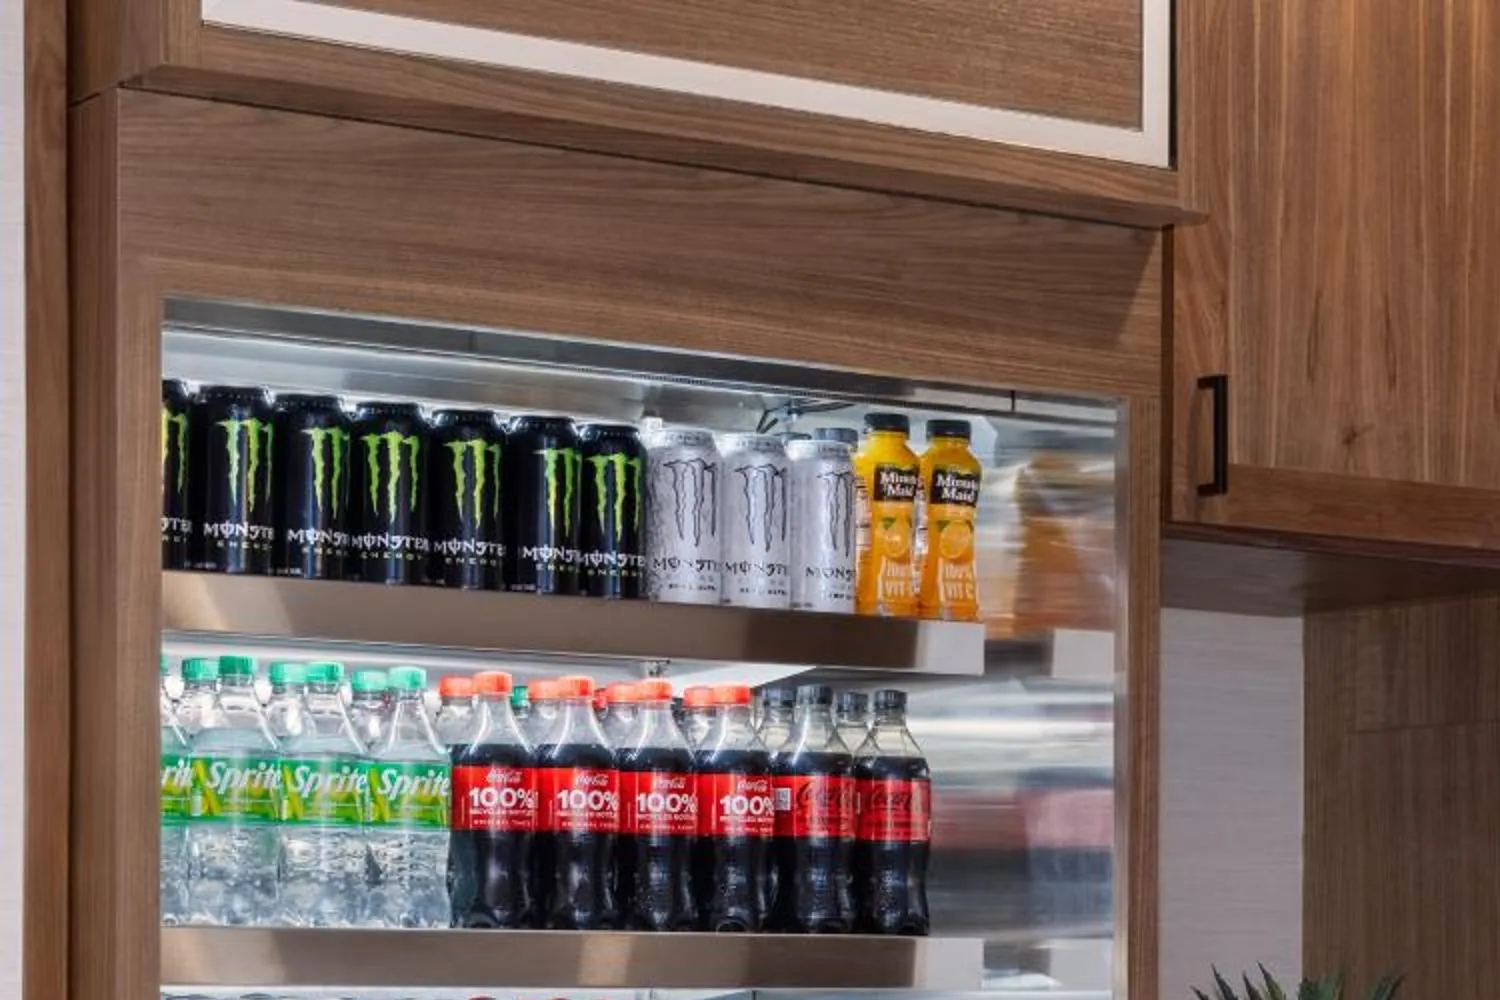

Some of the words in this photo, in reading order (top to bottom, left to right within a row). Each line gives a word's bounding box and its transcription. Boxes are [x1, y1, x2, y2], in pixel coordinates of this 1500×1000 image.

[204, 520, 274, 540] MONSTE
[433, 537, 506, 556] MONSTE
[580, 550, 646, 568] MONSTE
[287, 765, 367, 798] Sprite
[469, 787, 536, 809] 100%
[557, 789, 618, 811] 100%
[637, 792, 697, 813] 100%
